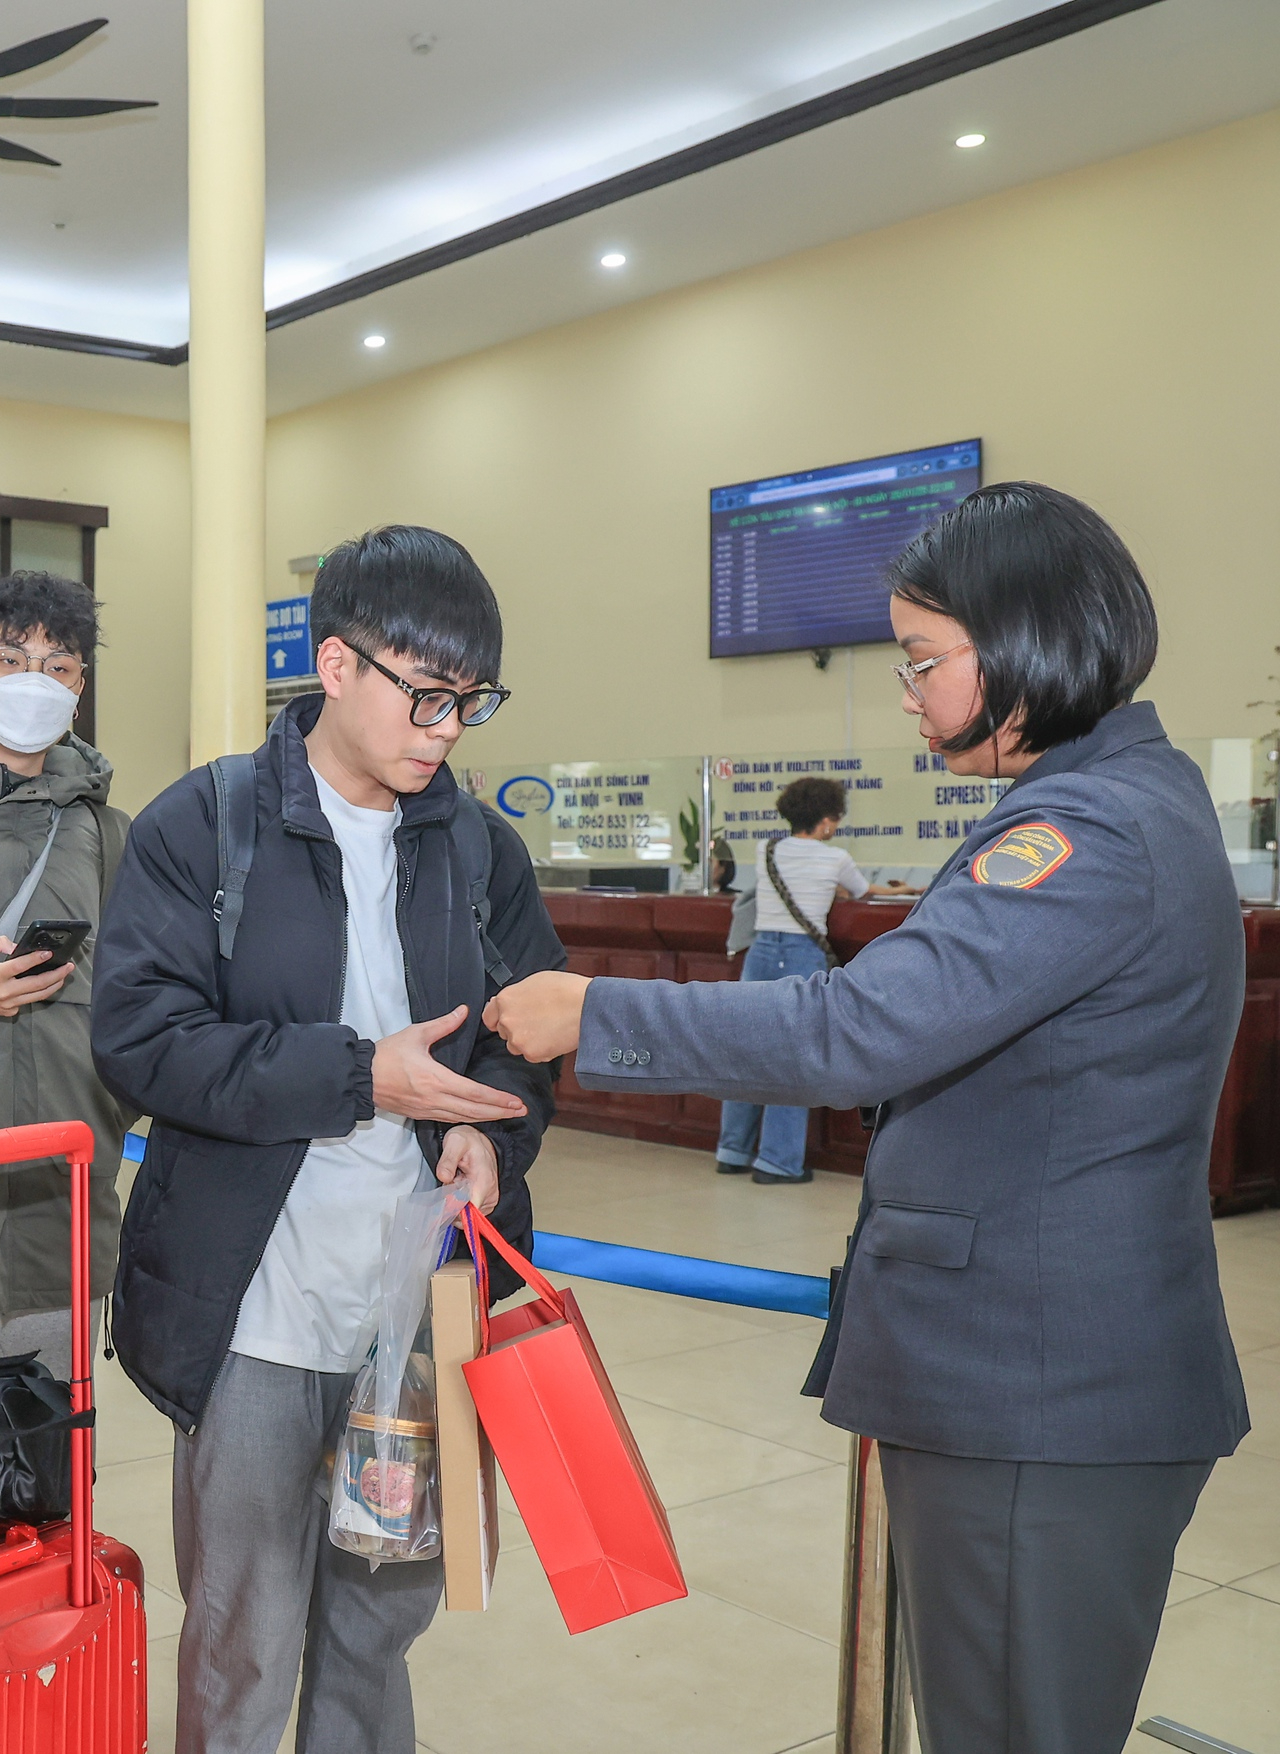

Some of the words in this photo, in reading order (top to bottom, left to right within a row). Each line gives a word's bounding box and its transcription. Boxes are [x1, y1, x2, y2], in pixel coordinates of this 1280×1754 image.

[787, 760, 825, 772] VIOLETTE
[829, 759, 862, 771] TRAINS
[631, 774, 649, 786] LAM
[618, 792, 644, 806] VINH
[936, 785, 985, 805] EXPRESS
[578, 815, 604, 829] 0962
[631, 814, 651, 828] 122
[578, 835, 604, 849] 0943
